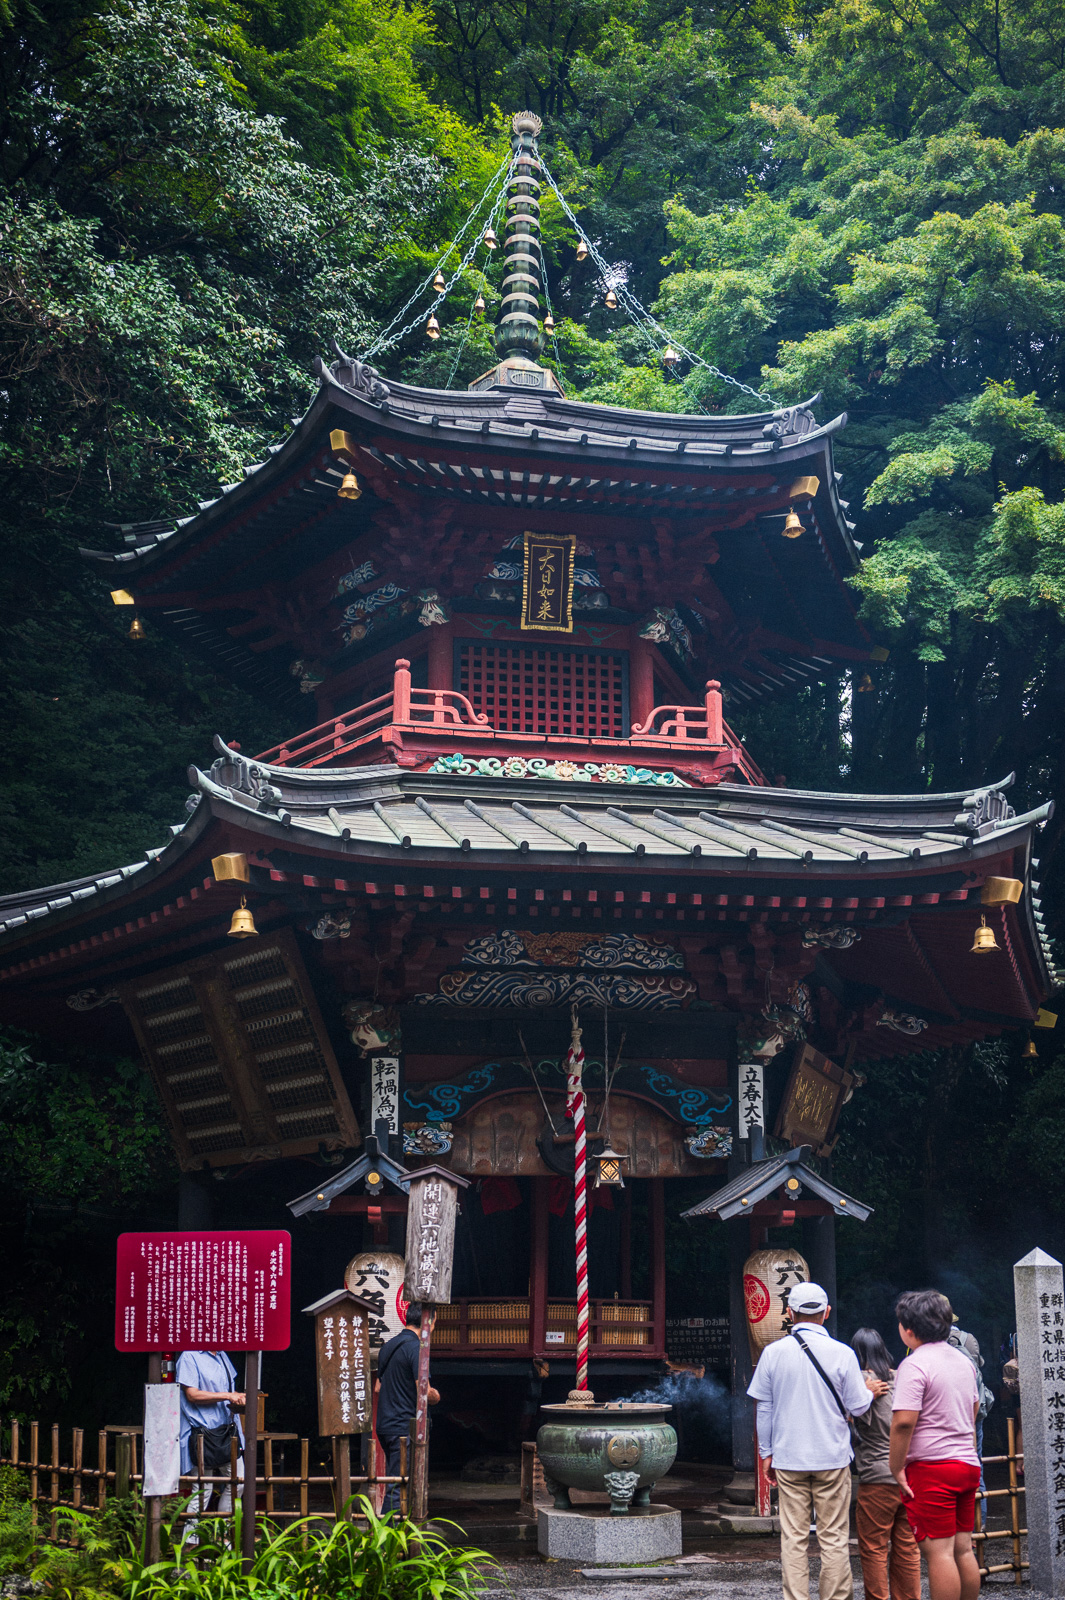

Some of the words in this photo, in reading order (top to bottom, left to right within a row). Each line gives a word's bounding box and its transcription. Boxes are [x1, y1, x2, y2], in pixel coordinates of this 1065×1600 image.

[536, 548, 555, 621] 大日如来
[417, 1183, 442, 1294] 開運六地蔵尊
[323, 1316, 335, 1361] 望みます
[338, 1316, 351, 1424] あなたの真心の供養を
[1039, 1292, 1055, 1381] 重要文化財
[1051, 1293, 1065, 1381] 群馬県指定
